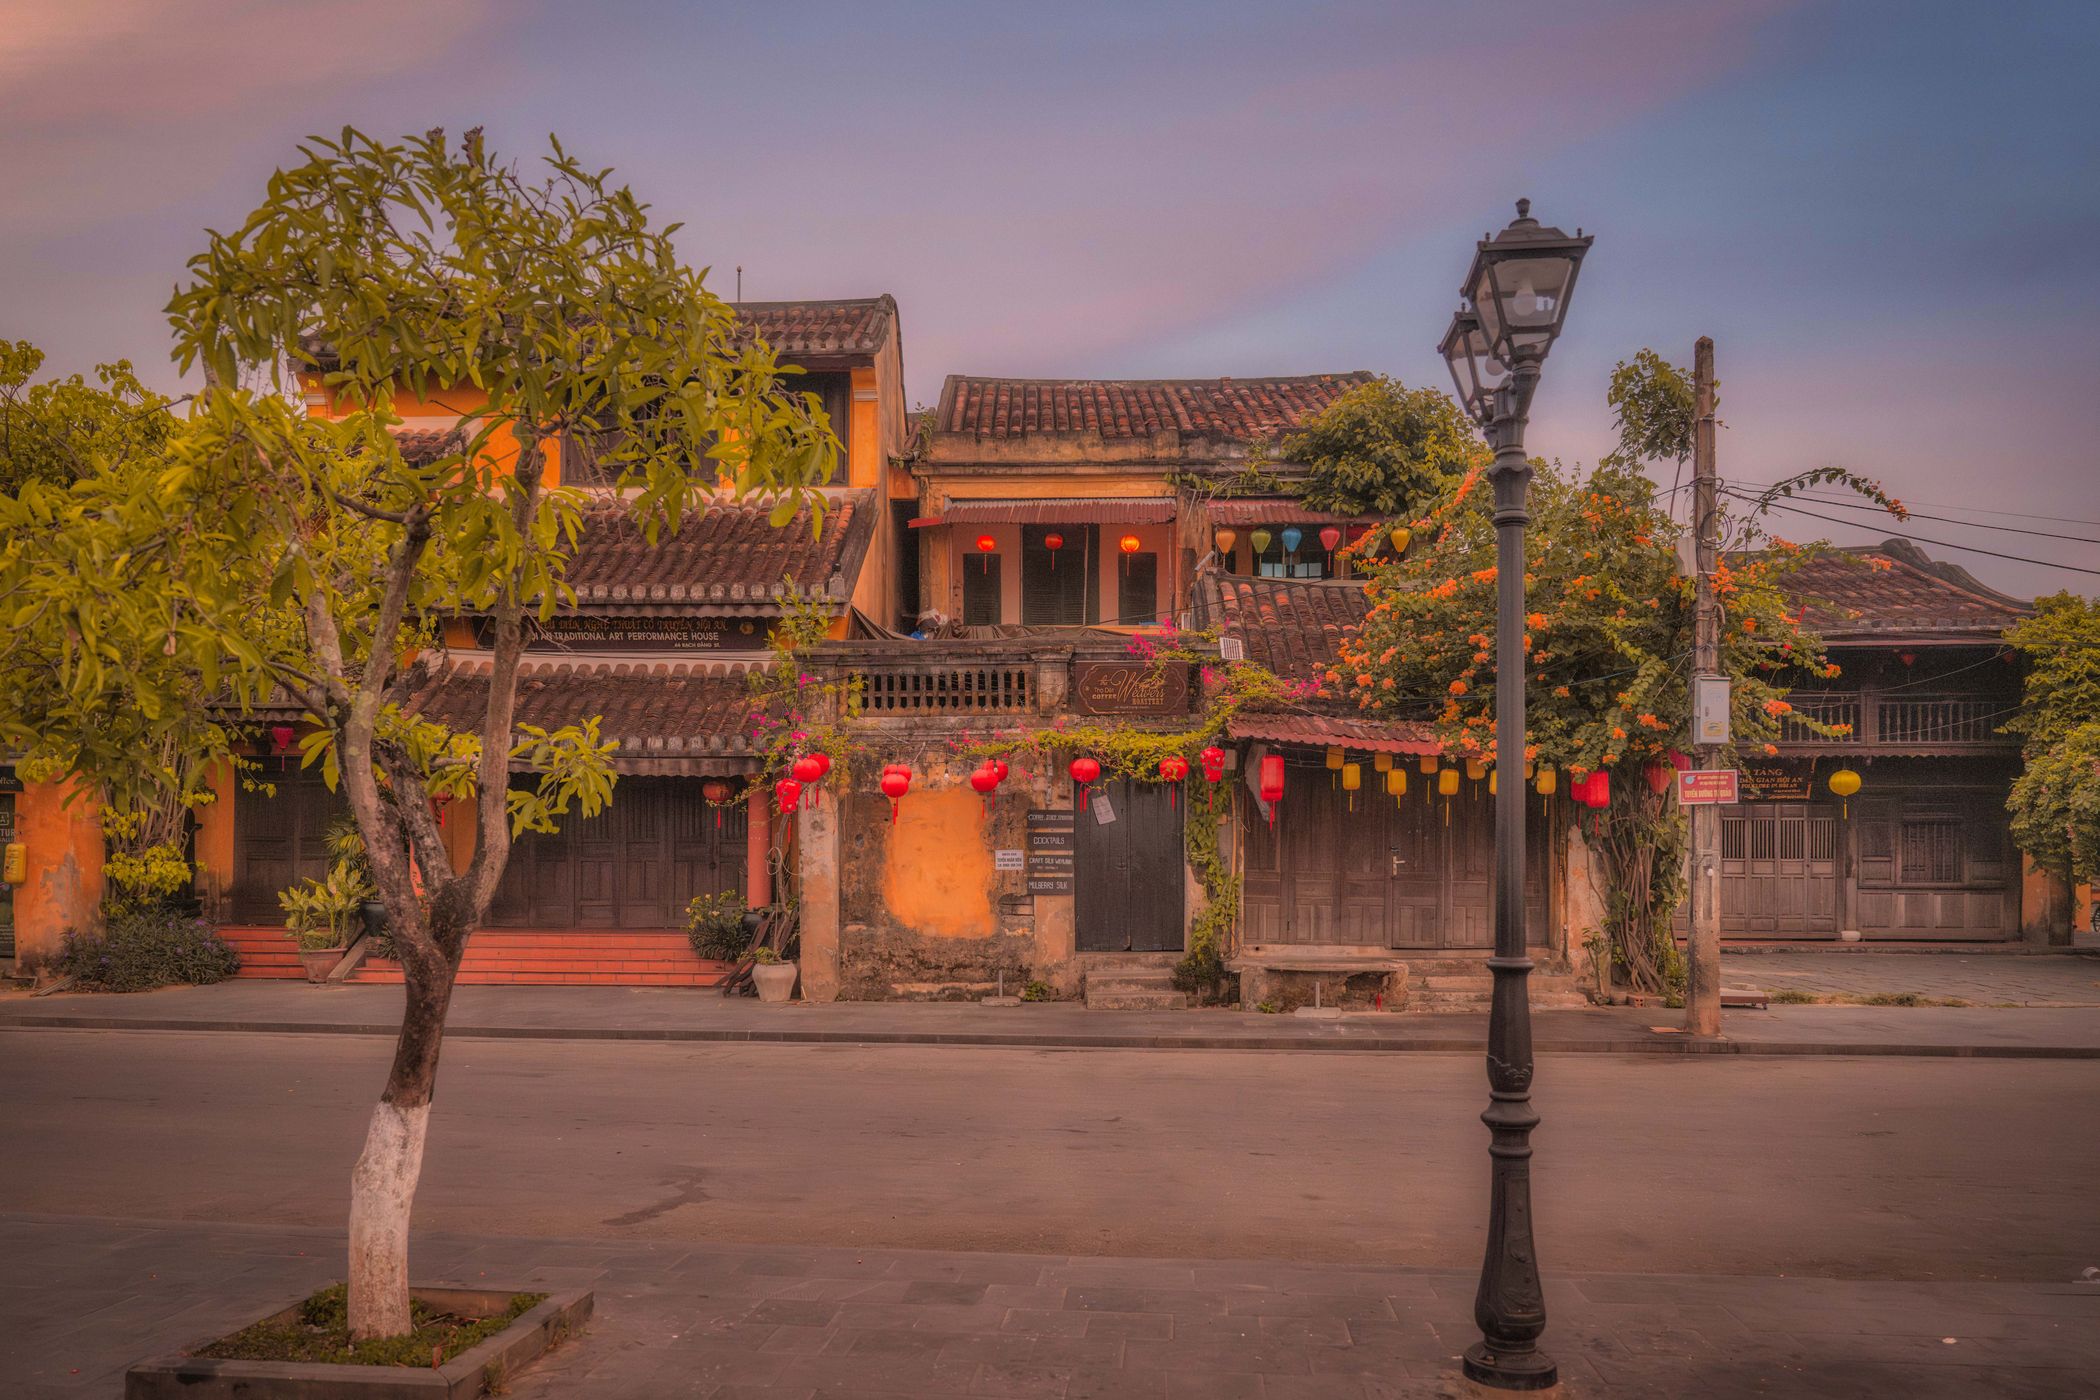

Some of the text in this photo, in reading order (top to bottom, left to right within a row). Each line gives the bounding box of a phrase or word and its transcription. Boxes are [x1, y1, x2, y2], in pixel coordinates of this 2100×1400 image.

[554, 631, 606, 641] TRADITIONAL
[609, 631, 624, 641] ART
[628, 631, 688, 641] PERFORMANCE
[692, 631, 719, 641] HOUSE
[1033, 837, 1065, 845] COCKTAILS
[1028, 881, 1068, 890] MULBERRY SILK
